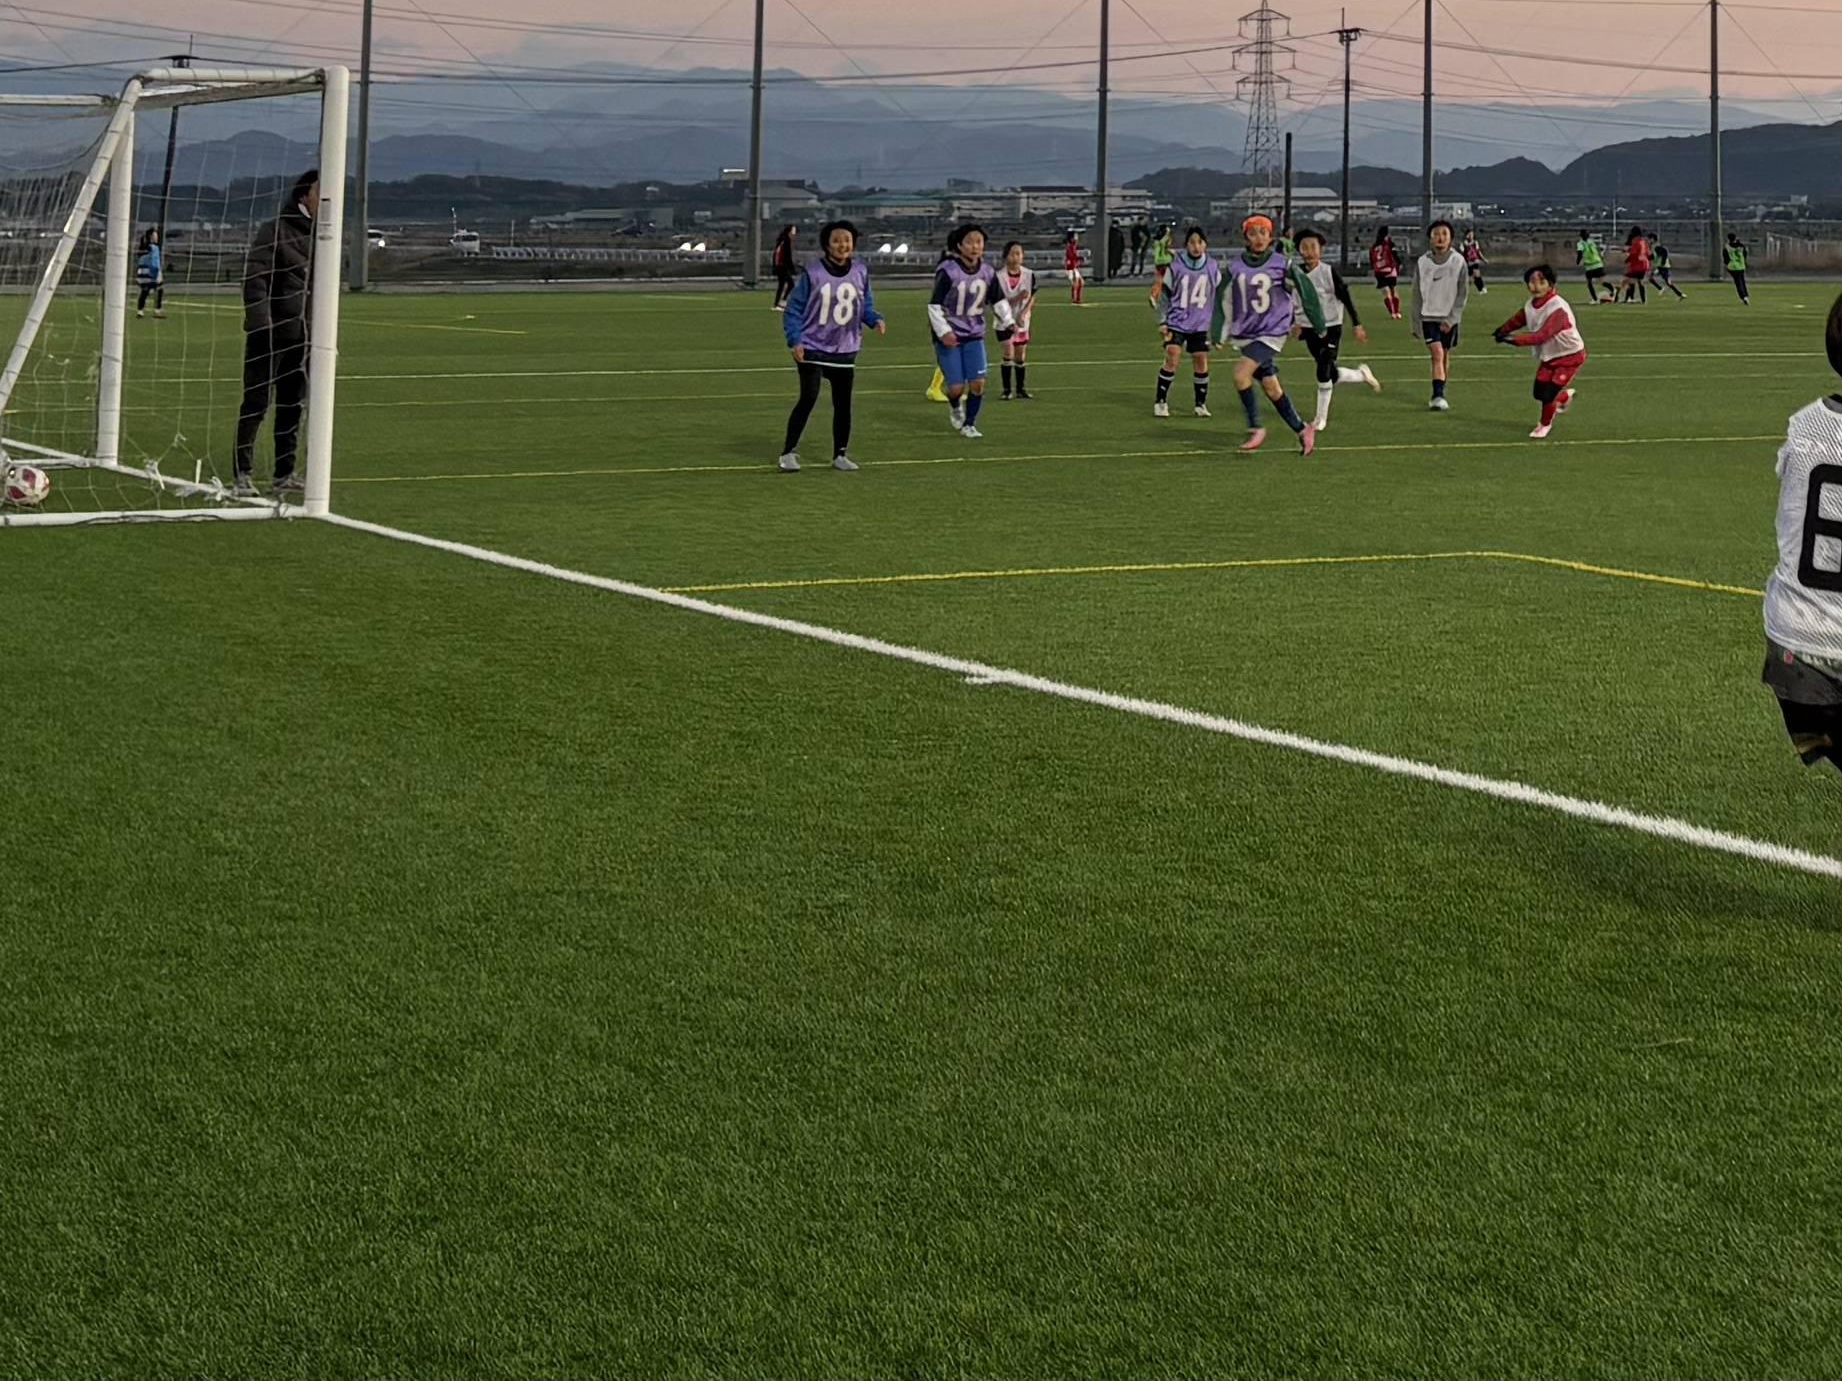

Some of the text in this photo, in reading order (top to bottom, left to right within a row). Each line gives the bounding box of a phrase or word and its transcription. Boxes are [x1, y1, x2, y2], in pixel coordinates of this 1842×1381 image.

[819, 282, 857, 325] 18
[956, 278, 987, 316] 12
[1181, 274, 1208, 309] 14
[1237, 273, 1271, 314] 13
